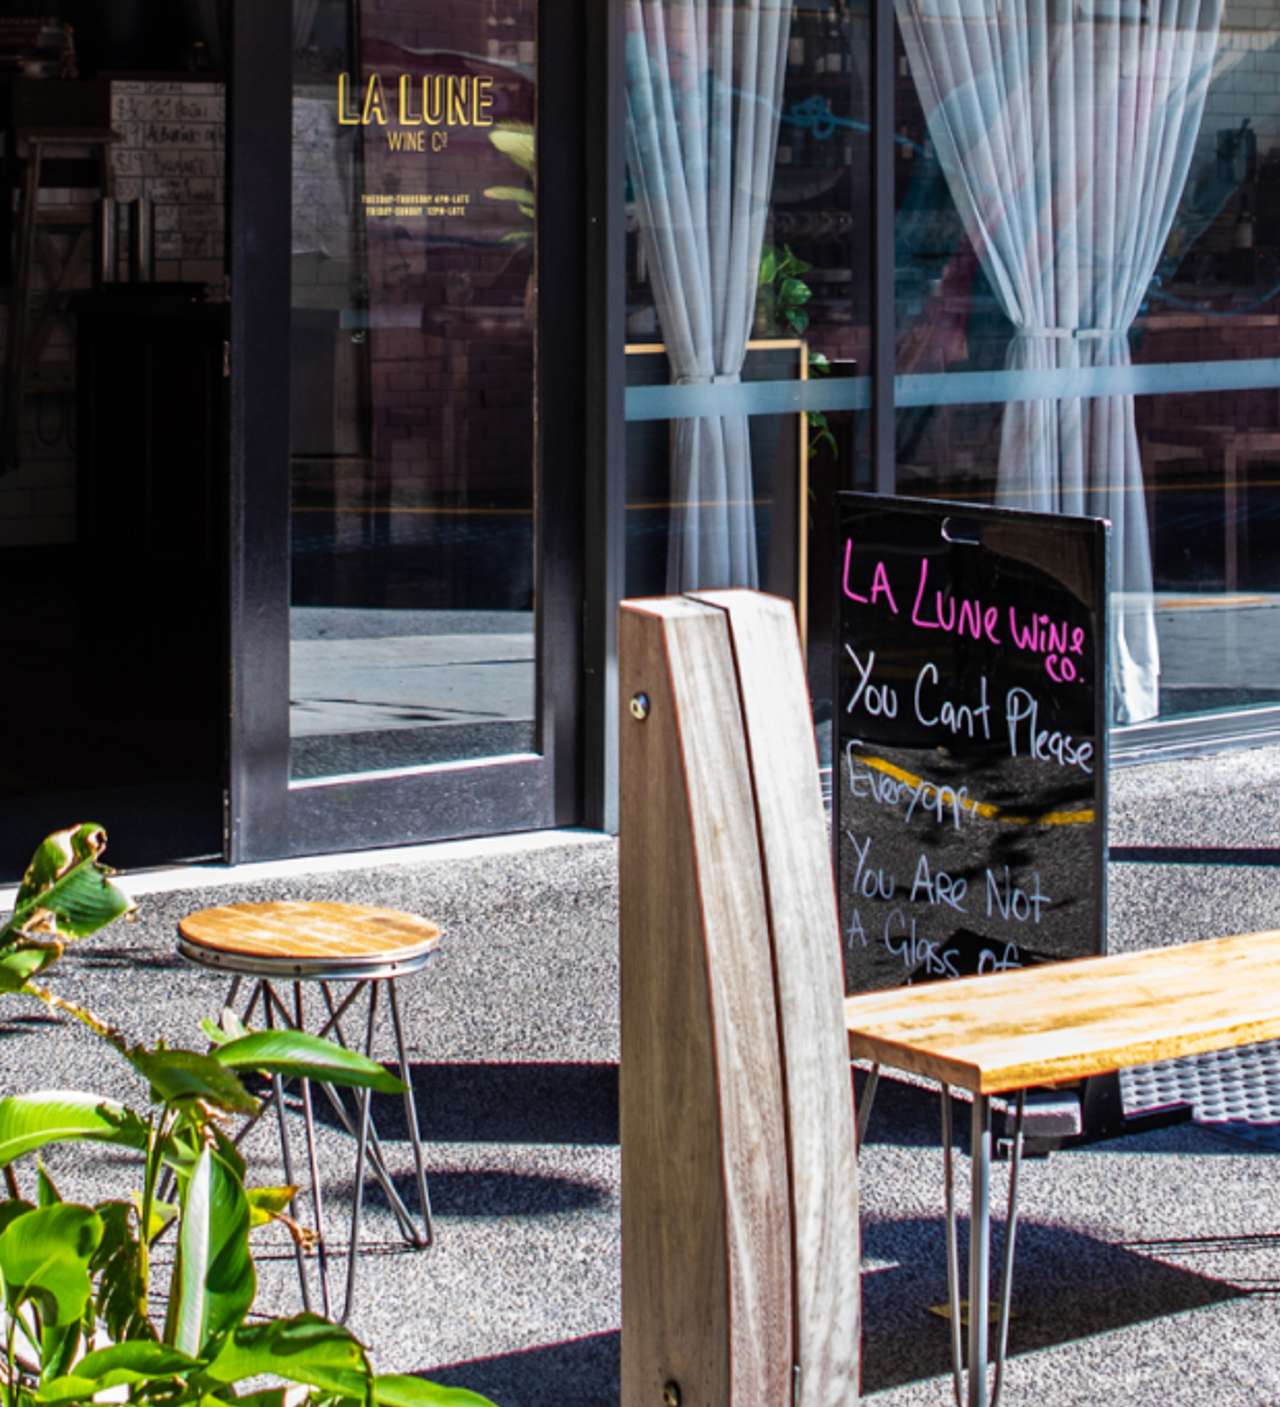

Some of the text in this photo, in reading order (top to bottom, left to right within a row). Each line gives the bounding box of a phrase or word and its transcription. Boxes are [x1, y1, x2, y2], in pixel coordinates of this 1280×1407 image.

[337, 72, 495, 127] LA LUNE
[387, 131, 425, 152] WINE
[842, 537, 899, 615] LA
[845, 643, 898, 719] You
[1006, 687, 1094, 773] Please
[847, 830, 895, 900] You
[985, 865, 1051, 924] Not
[847, 908, 867, 949] A
[884, 909, 961, 980] Glass
